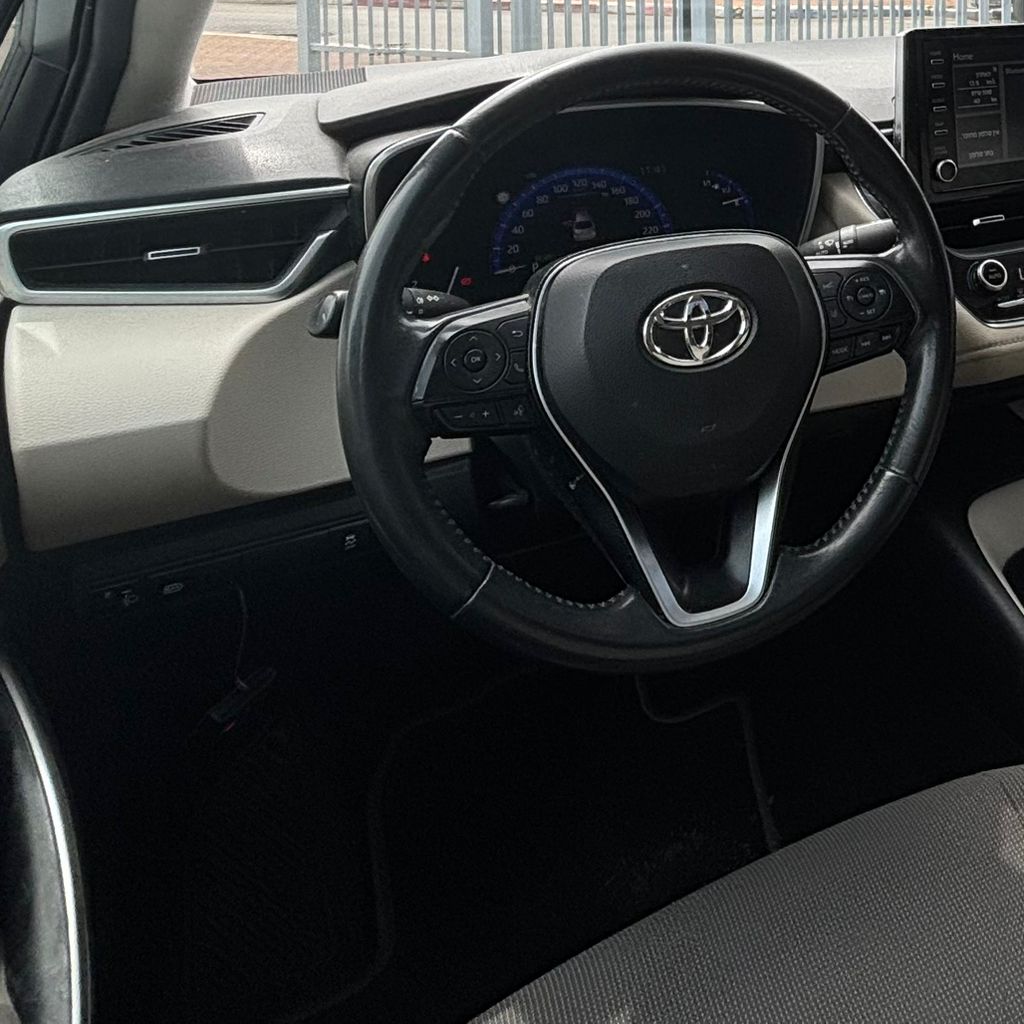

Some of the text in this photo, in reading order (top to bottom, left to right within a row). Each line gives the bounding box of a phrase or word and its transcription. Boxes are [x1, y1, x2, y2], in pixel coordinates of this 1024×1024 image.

[553, 183, 569, 193] 100
[572, 178, 588, 188] 120
[591, 180, 608, 189] 140
[611, 185, 627, 195] 160
[536, 194, 549, 205] 80
[624, 196, 640, 207] 180
[522, 208, 535, 218] 60
[633, 208, 652, 219] 200
[511, 224, 525, 235] 40
[642, 225, 660, 236] 220
[507, 244, 520, 256] 20
